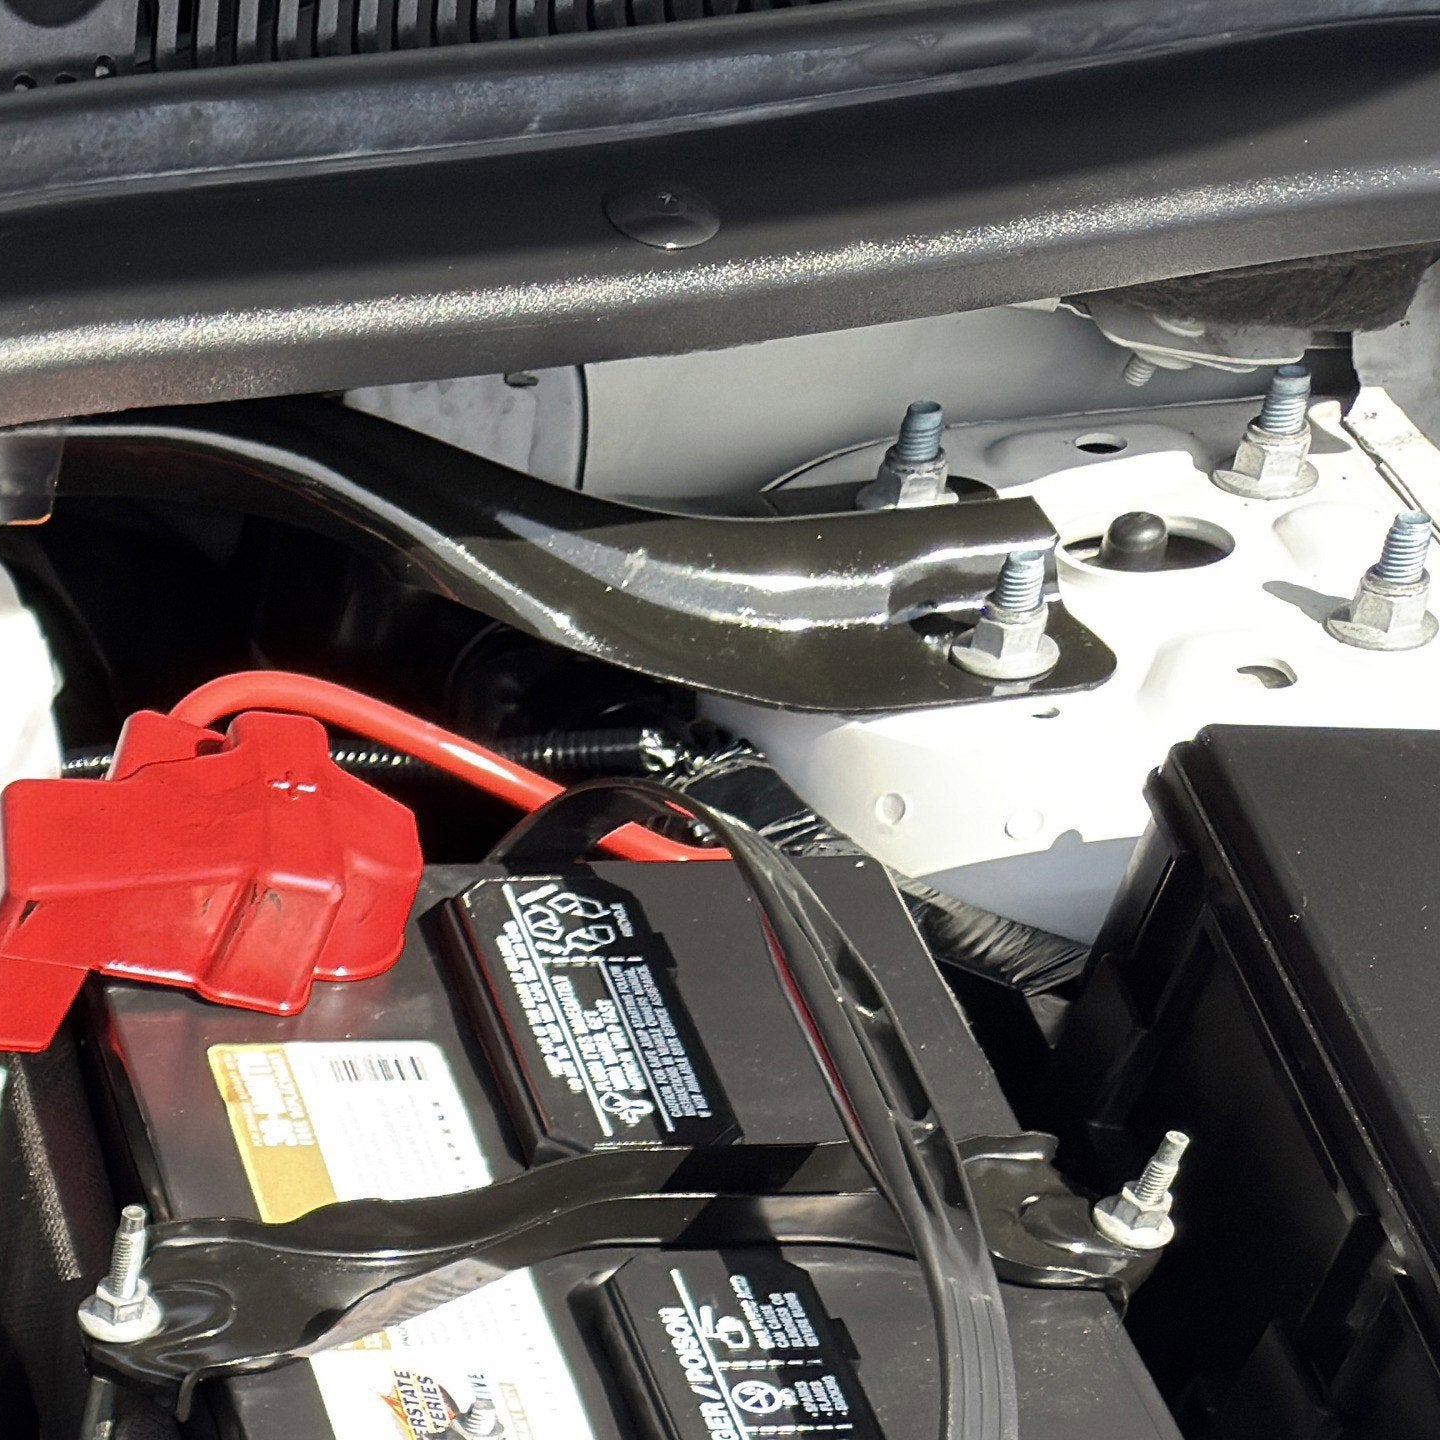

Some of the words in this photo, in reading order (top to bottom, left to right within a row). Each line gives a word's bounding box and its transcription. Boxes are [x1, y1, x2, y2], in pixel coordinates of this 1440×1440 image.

[656, 1307, 715, 1383] POISON
[393, 1369, 429, 1435] ERSTATE
[416, 1374, 449, 1430] TERIES
